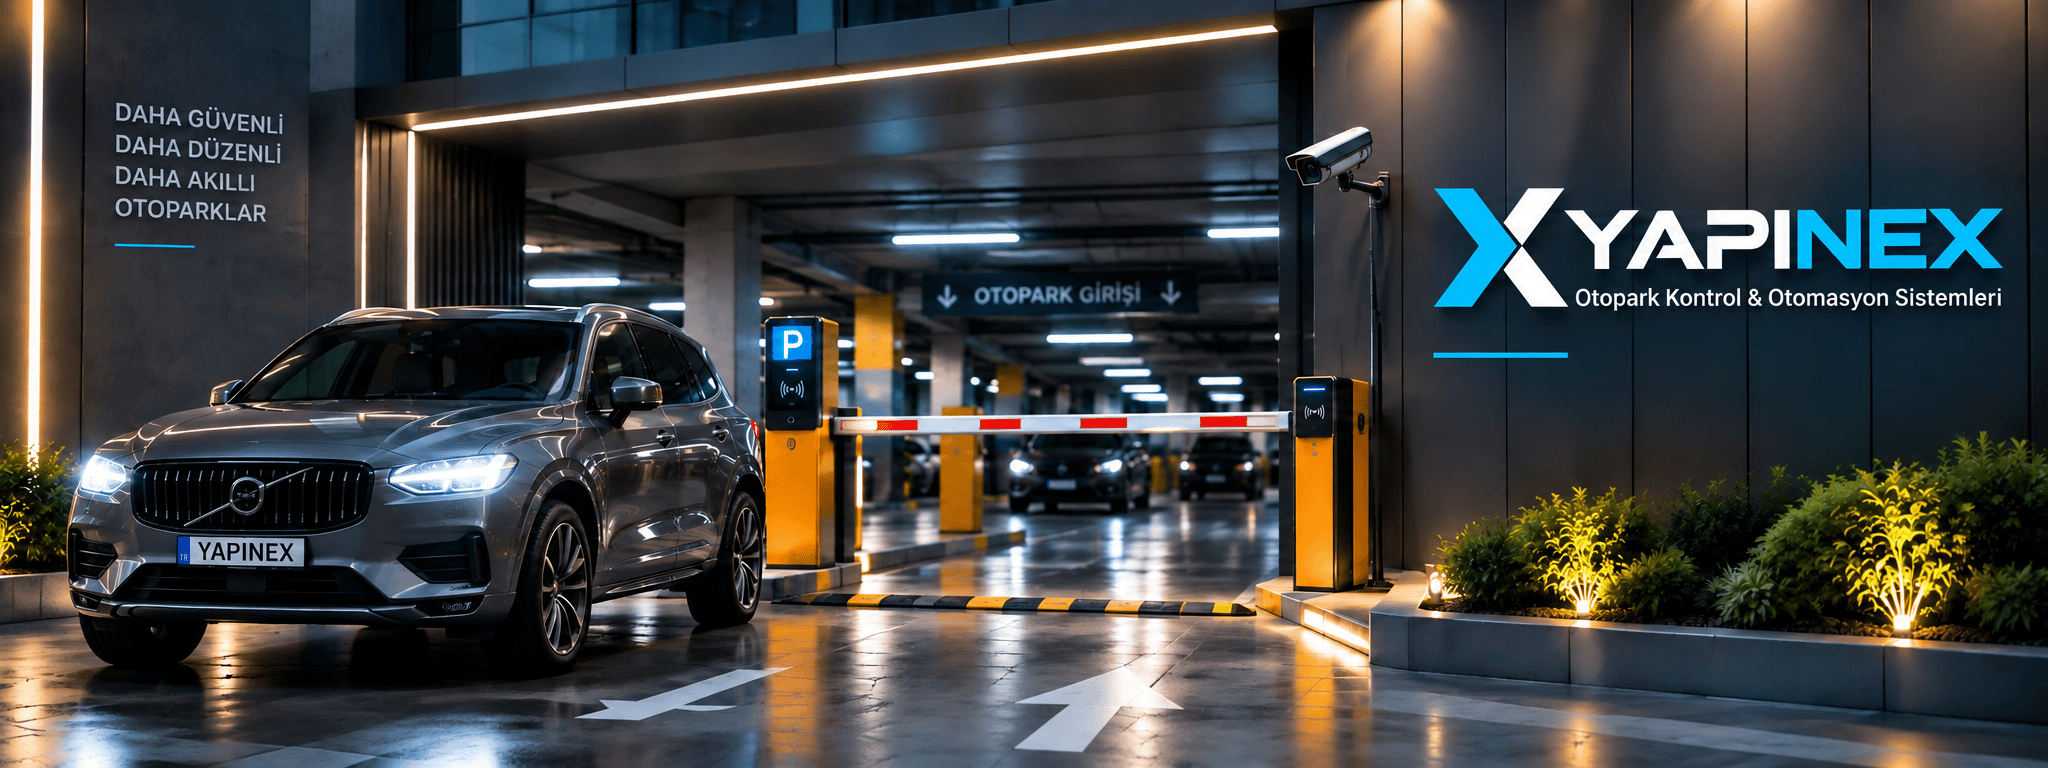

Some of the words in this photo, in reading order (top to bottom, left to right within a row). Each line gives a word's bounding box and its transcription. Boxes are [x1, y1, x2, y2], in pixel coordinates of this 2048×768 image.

[115, 102, 182, 127] DAHA
[188, 106, 283, 135] GÜVENLİ
[115, 134, 181, 157] DAHA
[188, 137, 281, 164] DÜZENLİ
[115, 165, 181, 189] DAHA
[187, 170, 255, 192] AKILLI
[115, 198, 267, 223] OTOPARKLAR
[1564, 208, 2004, 270] YAPINEX
[974, 285, 1073, 305] OTOPARK
[1079, 281, 1141, 307] GİRİŞİ
[1575, 288, 1660, 311] Otopark
[1666, 287, 1741, 307] Kontrol
[1747, 288, 1763, 307] &
[1768, 288, 1889, 311] Otomasyon
[1895, 288, 2002, 307] Sistemleri
[783, 330, 803, 359] P
[180, 553, 189, 562] TR
[198, 541, 294, 562] YAPINEX
